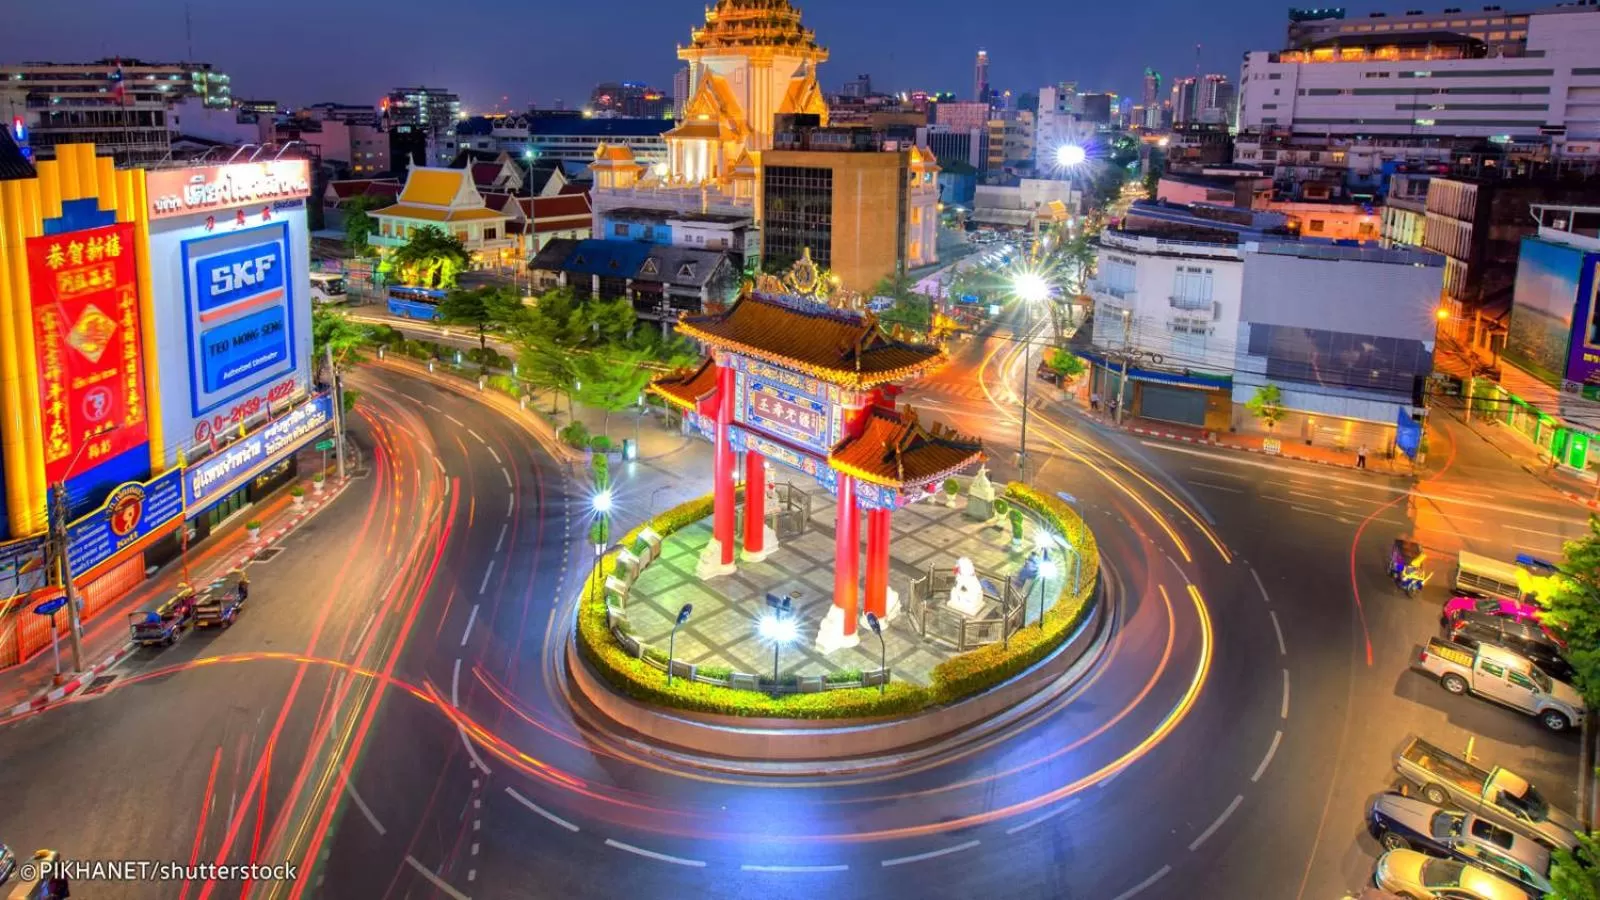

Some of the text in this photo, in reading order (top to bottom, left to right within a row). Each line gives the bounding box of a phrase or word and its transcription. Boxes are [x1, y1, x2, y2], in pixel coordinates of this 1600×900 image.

[45, 233, 121, 270] 恭賀新禧
[210, 254, 276, 296] SKF
[209, 341, 230, 356] TEO
